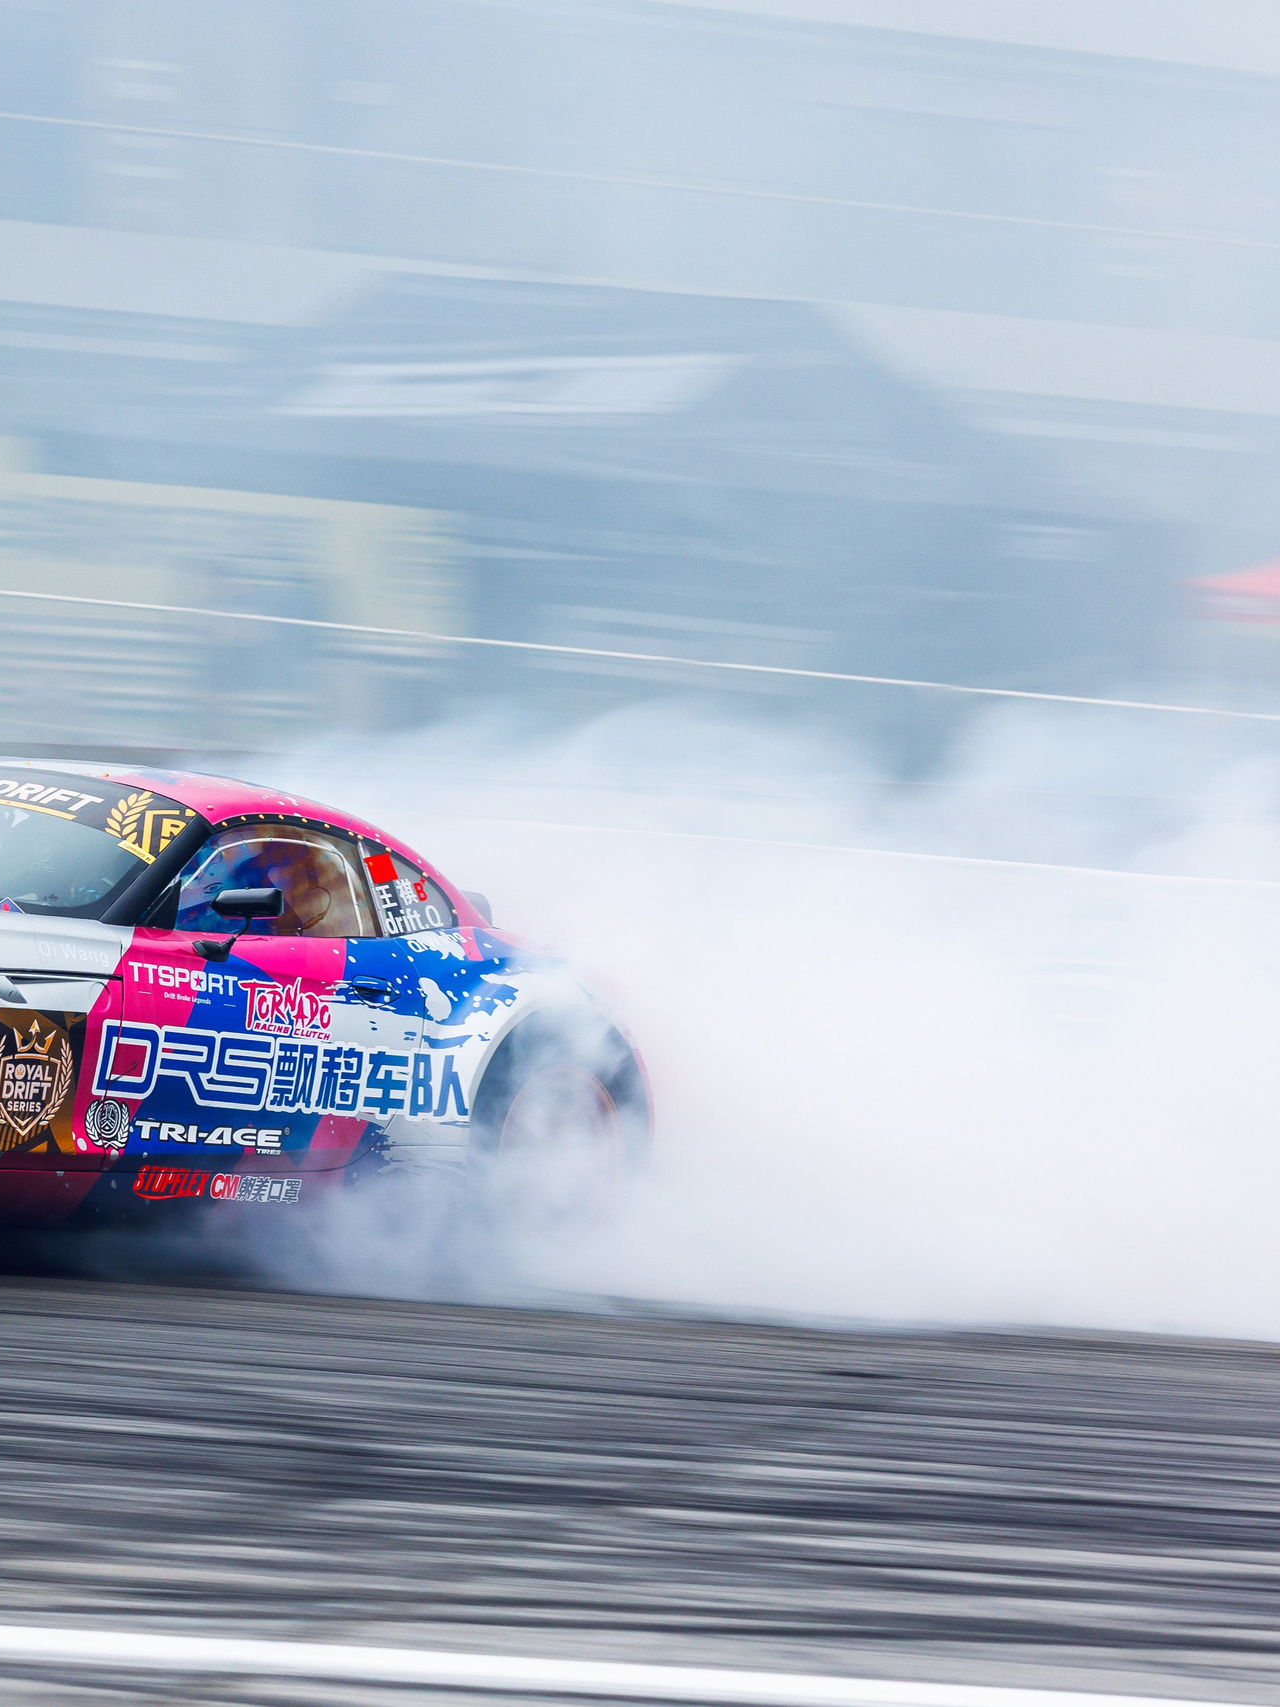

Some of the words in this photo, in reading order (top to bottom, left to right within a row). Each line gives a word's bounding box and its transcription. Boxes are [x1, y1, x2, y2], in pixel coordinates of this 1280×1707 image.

[385, 905, 445, 935] drift.Q
[39, 940, 58, 958] Qi
[60, 942, 110, 968] Wang
[128, 961, 238, 996] TTSPORT
[163, 991, 176, 1000] Drift
[176, 993, 191, 1002] Brake
[191, 996, 212, 1005] Legends
[239, 977, 332, 1030] TORNADO
[254, 1022, 290, 1035] RACING
[294, 1028, 331, 1041] CLUTCH
[5, 1063, 53, 1082] ROYAL
[2, 1081, 52, 1101] DRIFT
[7, 1101, 42, 1113] SERIES
[134, 1119, 283, 1148] TRI-ACE
[255, 1148, 282, 1156] TIRES
